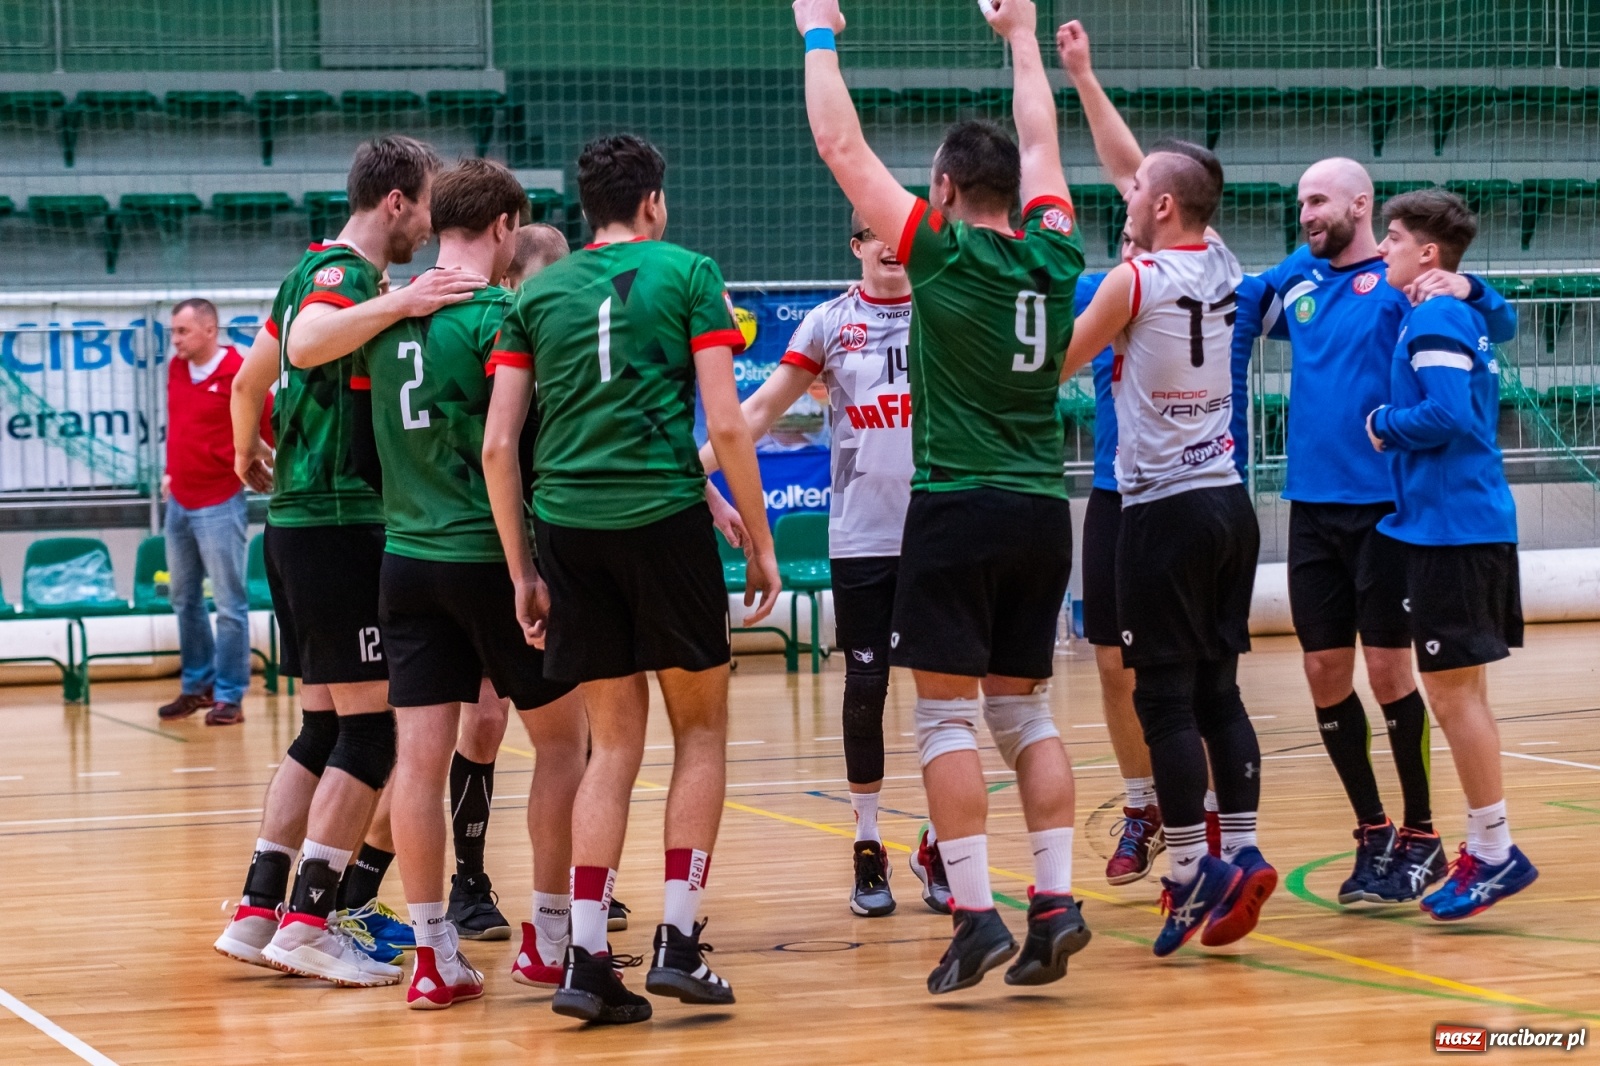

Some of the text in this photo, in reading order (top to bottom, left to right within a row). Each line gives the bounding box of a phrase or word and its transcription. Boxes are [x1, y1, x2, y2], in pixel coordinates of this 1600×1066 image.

[598, 296, 612, 383] 1
[1012, 290, 1048, 373] 9
[887, 344, 912, 385] 14
[398, 341, 430, 430] 2
[1151, 390, 1208, 400] RADIO
[358, 626, 383, 663] 12
[688, 855, 705, 892] KIPSTA
[600, 876, 616, 912] KIPSTA
